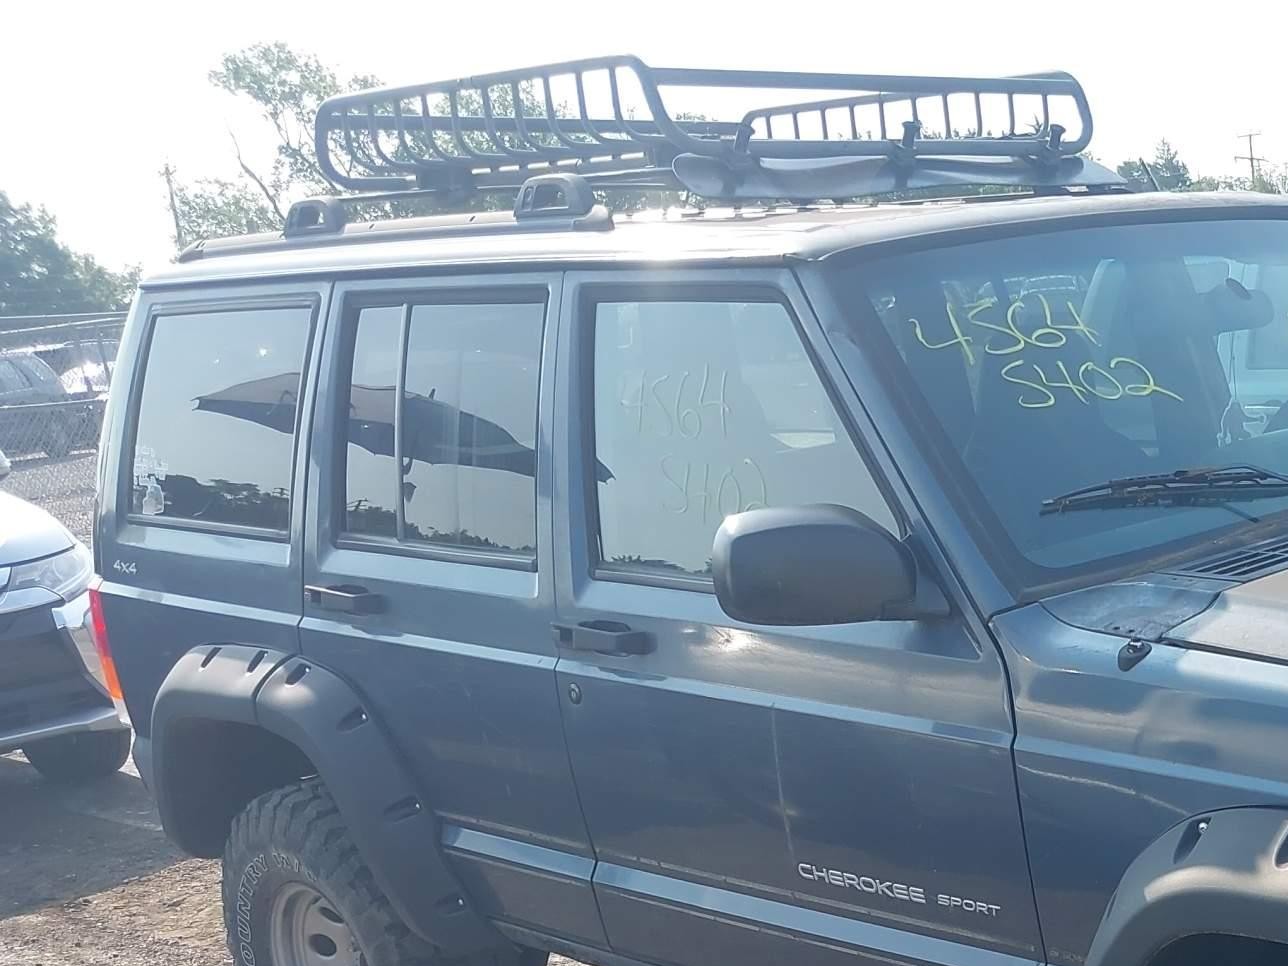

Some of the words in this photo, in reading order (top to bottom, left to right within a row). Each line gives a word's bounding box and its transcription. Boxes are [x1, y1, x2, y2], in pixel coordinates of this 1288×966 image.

[908, 294, 1102, 365] 4564
[620, 361, 731, 439] 4564
[1001, 357, 1184, 408] 5402
[798, 863, 926, 904] CHEROKEE
[937, 894, 1001, 917] SPORT
